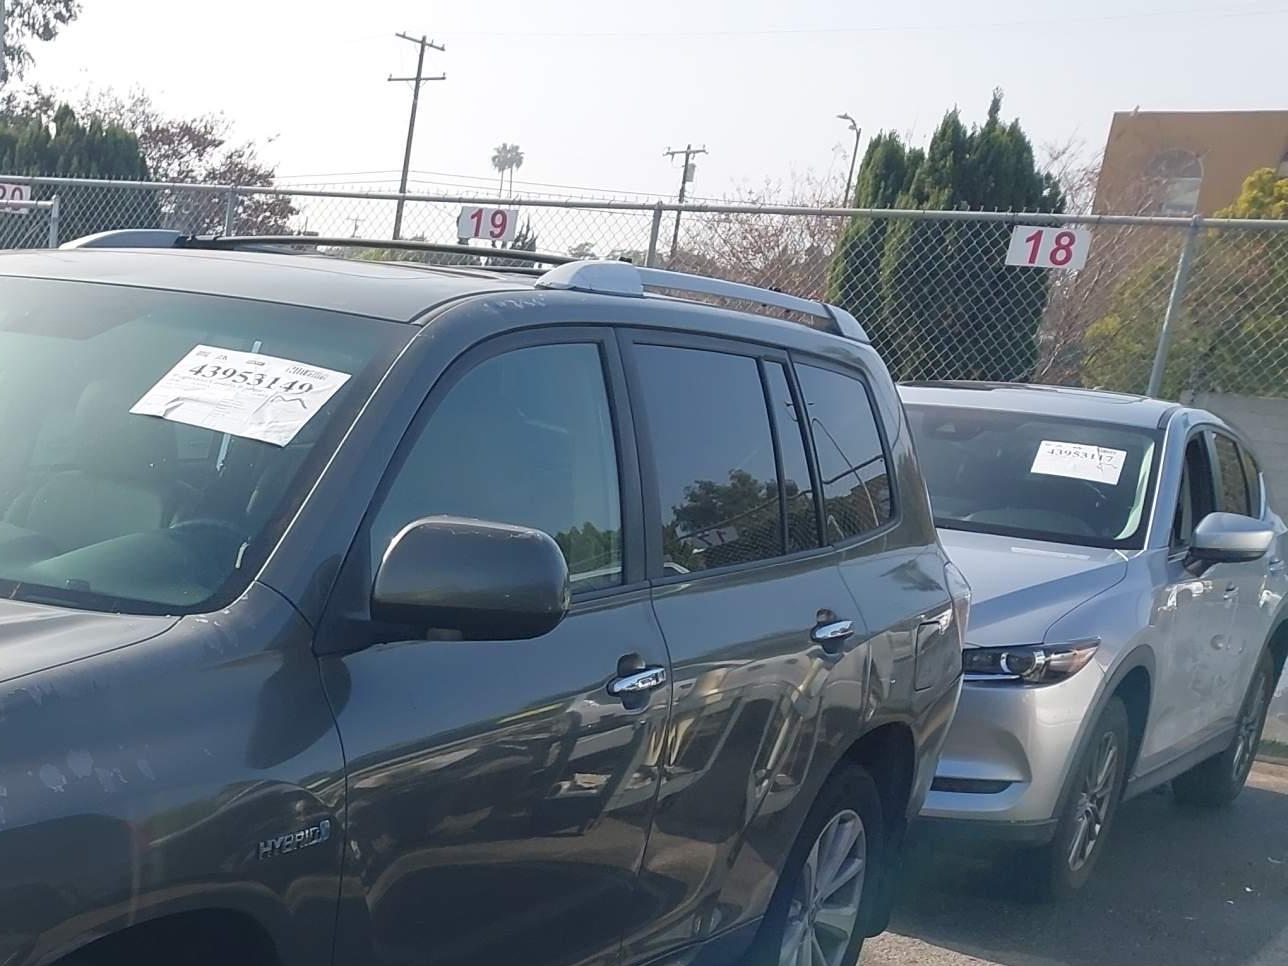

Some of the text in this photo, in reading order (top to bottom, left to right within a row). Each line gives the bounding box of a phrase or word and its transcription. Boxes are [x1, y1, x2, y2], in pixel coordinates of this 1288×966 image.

[470, 208, 508, 239] 19
[1024, 229, 1077, 266] 18
[188, 363, 314, 395] 43953149
[258, 826, 322, 861] HYBRID
